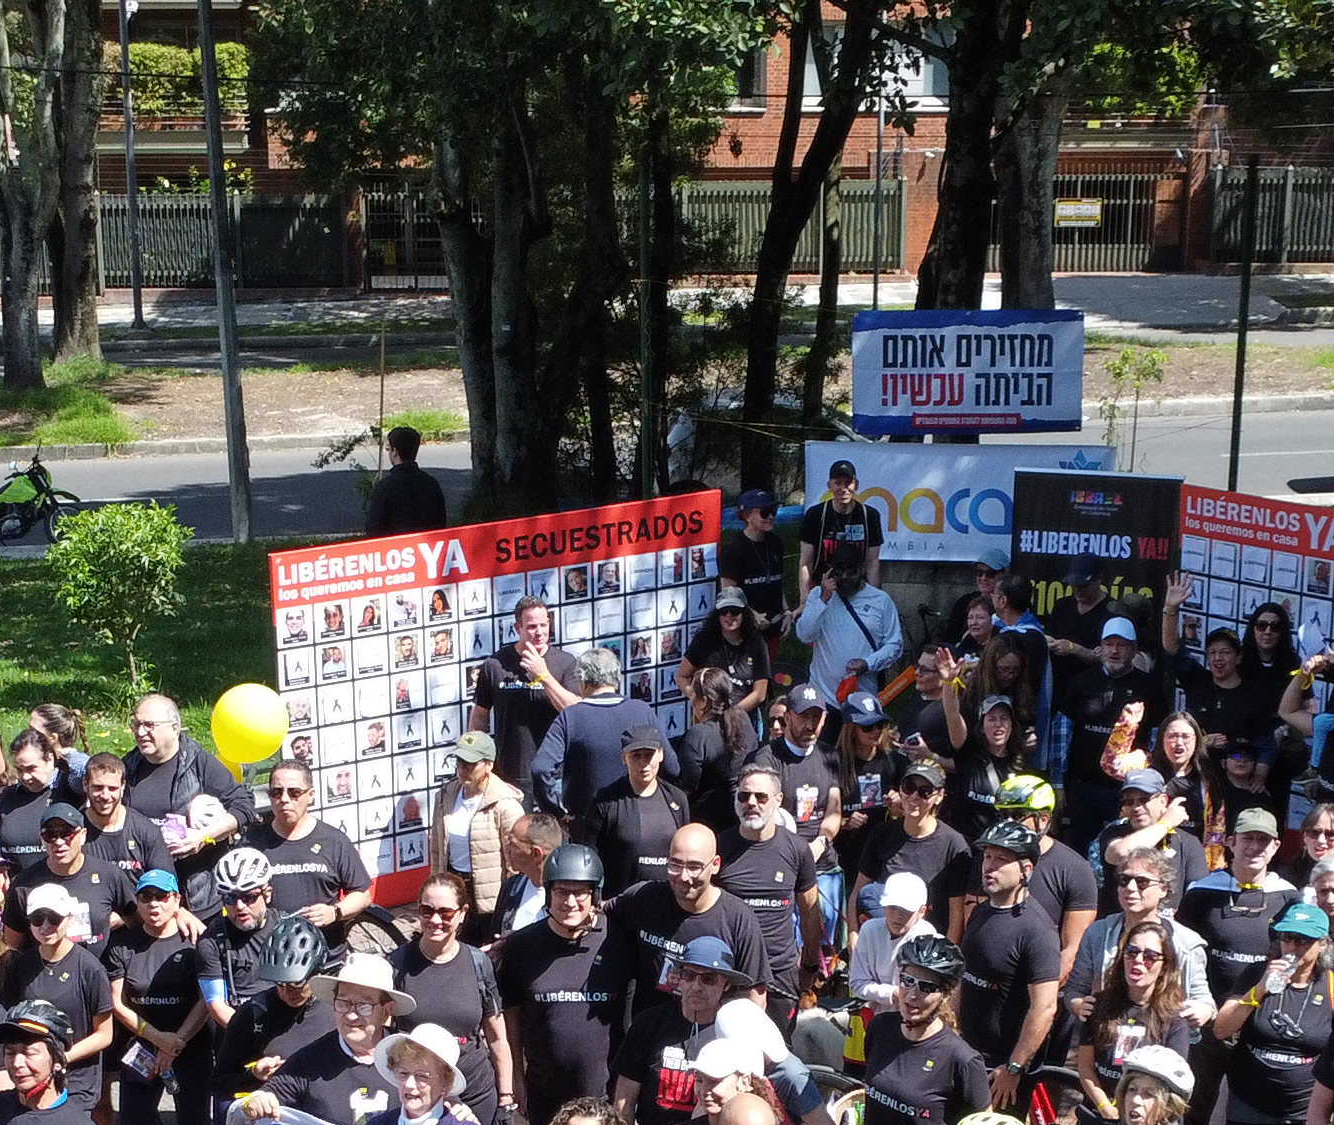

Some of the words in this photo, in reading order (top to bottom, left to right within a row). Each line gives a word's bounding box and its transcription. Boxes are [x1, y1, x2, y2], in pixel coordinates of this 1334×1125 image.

[882, 334, 946, 369] אותם
[955, 333, 1054, 368] מחזירים
[881, 372, 964, 407] עכשיו!
[974, 372, 1053, 406] הביתה
[1186, 495, 1301, 532] LIBÉRENLOS
[277, 547, 416, 586] LIBÉRENLOS
[419, 539, 470, 579] YA
[495, 510, 704, 564] SECUESTRADOS
[1184, 516, 1201, 530] los
[1202, 521, 1255, 540] queremos
[1257, 530, 1270, 541] en
[1273, 534, 1299, 548] casa
[278, 588, 299, 602] los
[301, 579, 365, 600] queremos
[367, 576, 383, 589] en
[385, 571, 416, 587] casa
